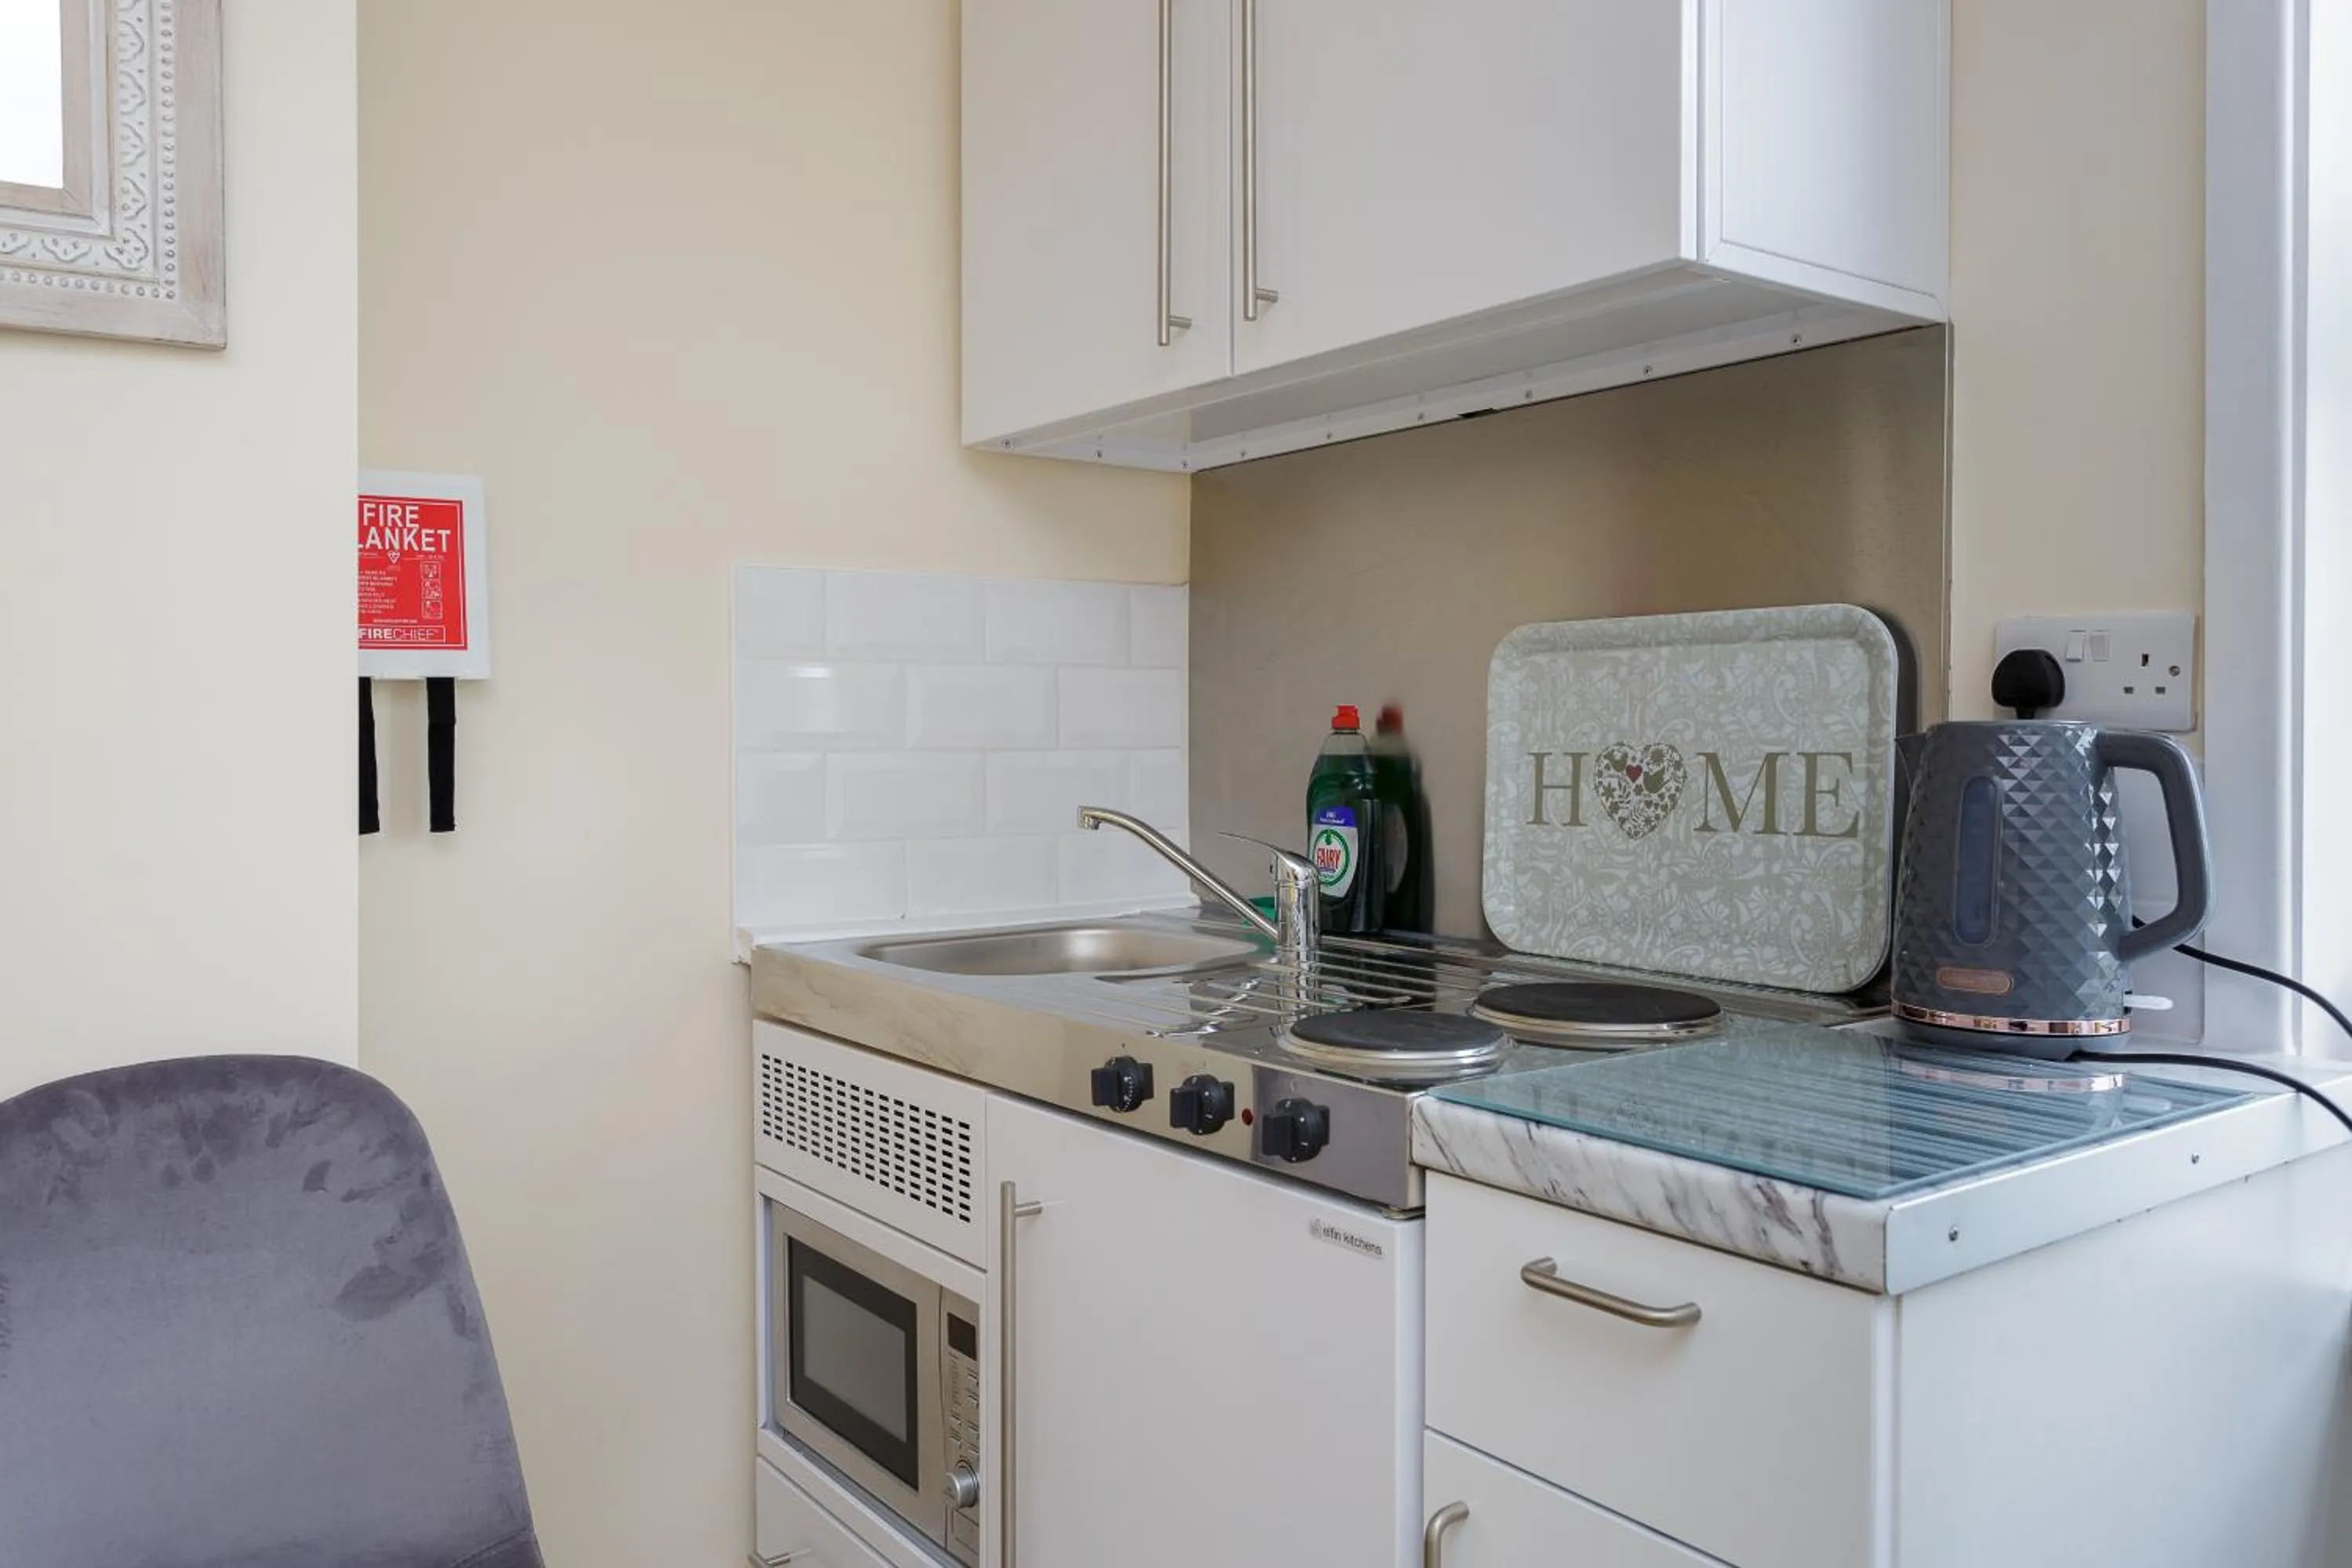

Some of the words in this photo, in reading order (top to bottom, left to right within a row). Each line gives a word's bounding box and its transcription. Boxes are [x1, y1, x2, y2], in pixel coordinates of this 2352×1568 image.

[363, 503, 420, 528] FIRE
[1317, 848, 1341, 869] FAIRY
[1343, 1230, 1382, 1255] kitchens
